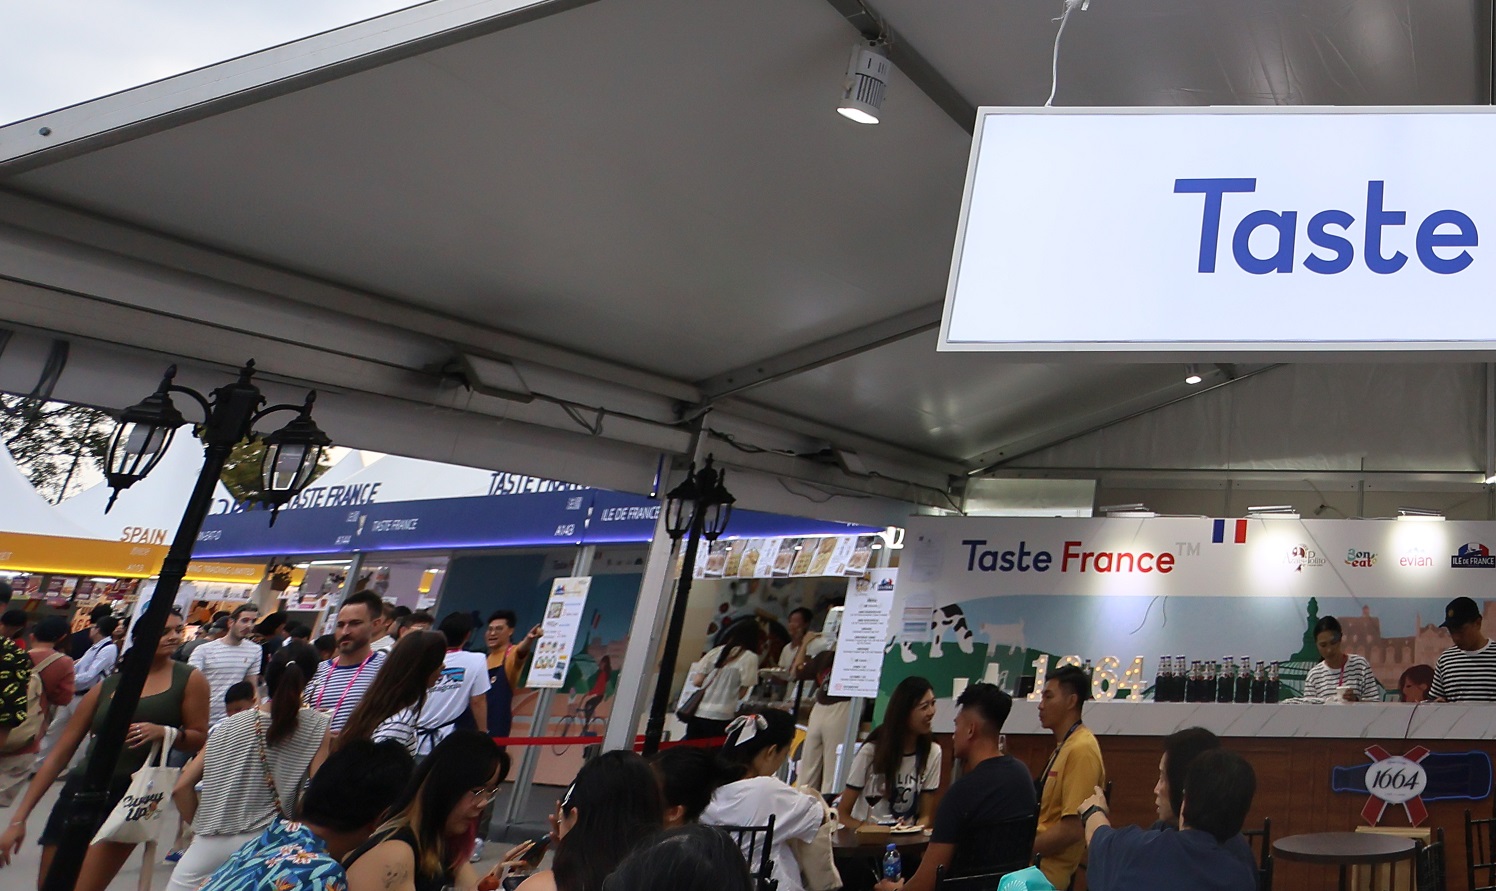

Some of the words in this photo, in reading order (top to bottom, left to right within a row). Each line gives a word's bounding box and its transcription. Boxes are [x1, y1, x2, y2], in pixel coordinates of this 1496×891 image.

[1174, 178, 1478, 275] Taste
[325, 482, 382, 507] FRANCE
[615, 507, 627, 521] DE
[627, 506, 661, 520] FRANCE
[120, 526, 168, 545] SPAIN
[961, 539, 1052, 572] Taste
[1061, 541, 1175, 573] France
[1400, 555, 1433, 566] evian
[1452, 557, 1462, 565] ILE
[1470, 557, 1494, 565] FRANCE
[1027, 654, 1148, 702] 164
[1372, 767, 1419, 790] 1664
